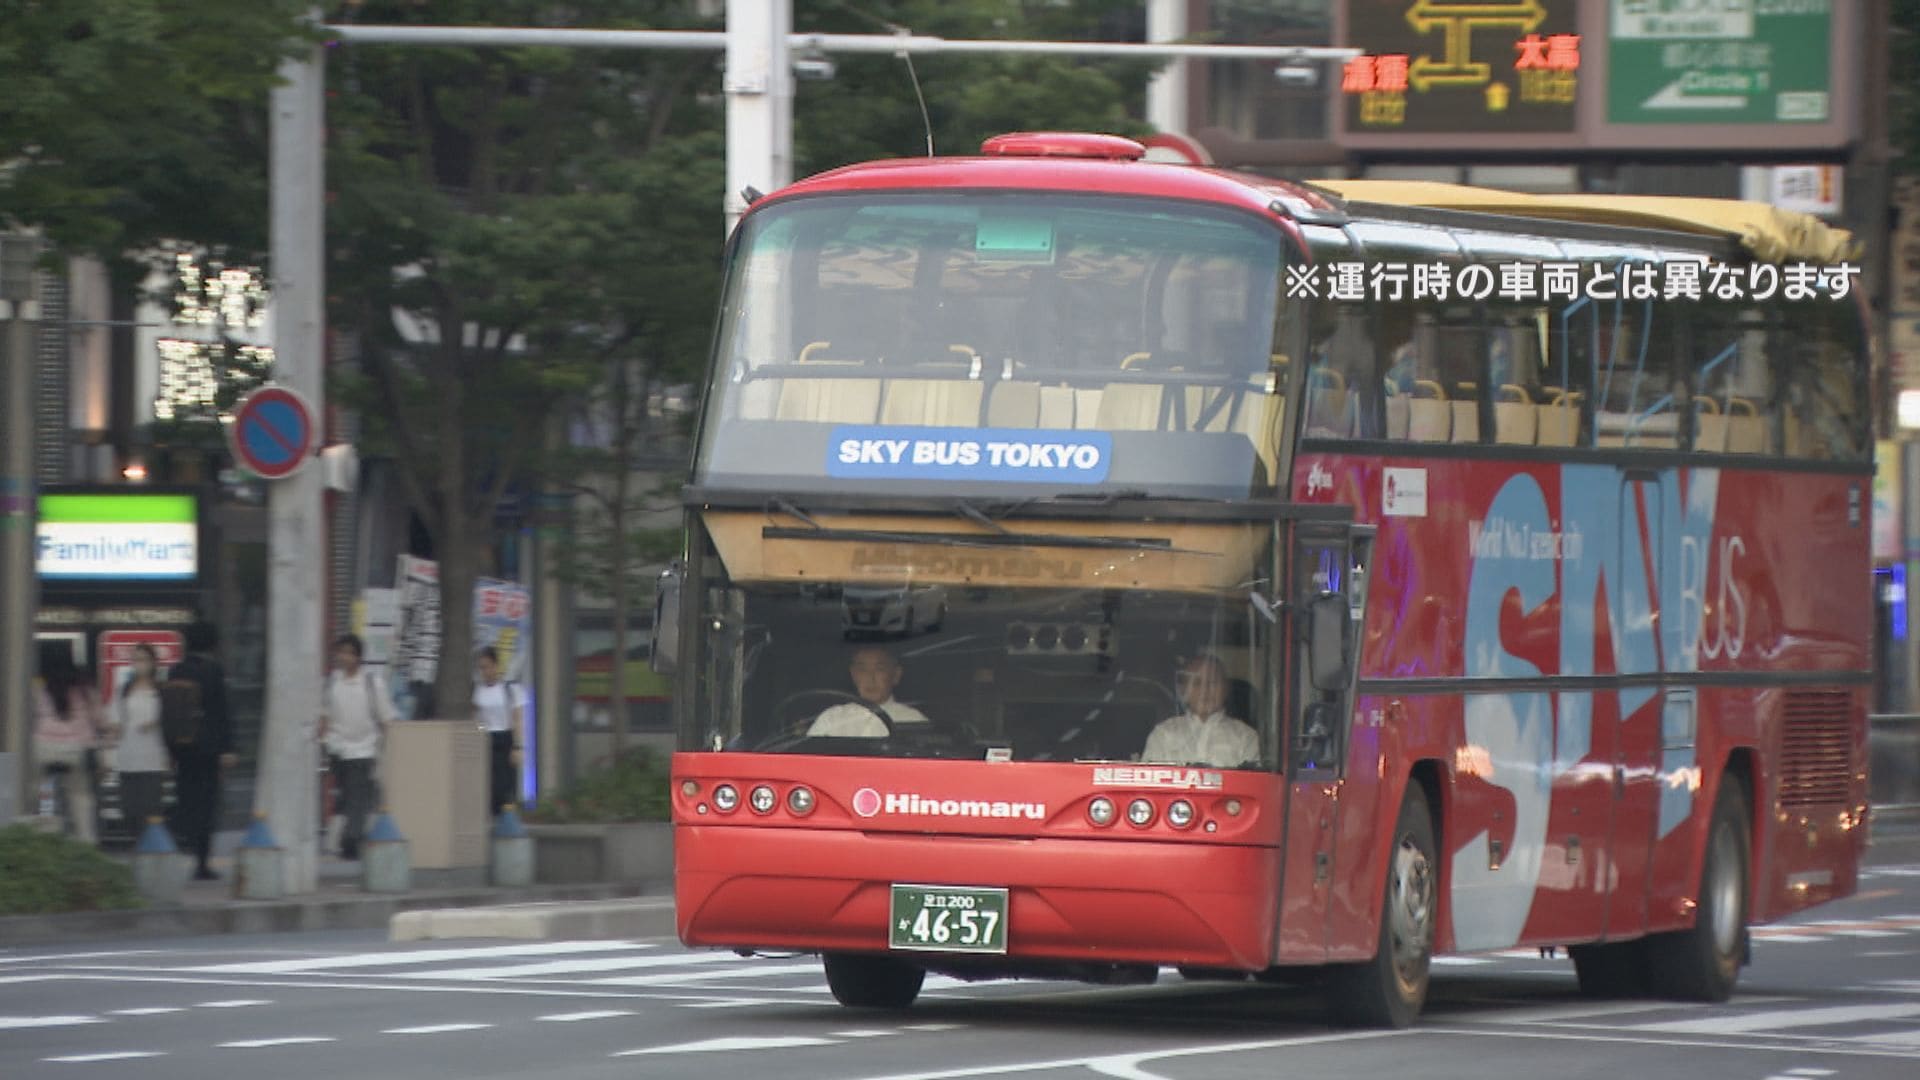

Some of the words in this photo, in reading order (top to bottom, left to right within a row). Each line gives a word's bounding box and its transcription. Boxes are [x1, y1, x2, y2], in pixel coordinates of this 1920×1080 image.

[838, 440, 908, 464] SKY
[912, 441, 980, 465] BUS
[986, 443, 1100, 469] TOKYO
[1681, 536, 1746, 660] BUS
[885, 794, 1046, 821] Hinomaru
[912, 908, 999, 944] 46-57
